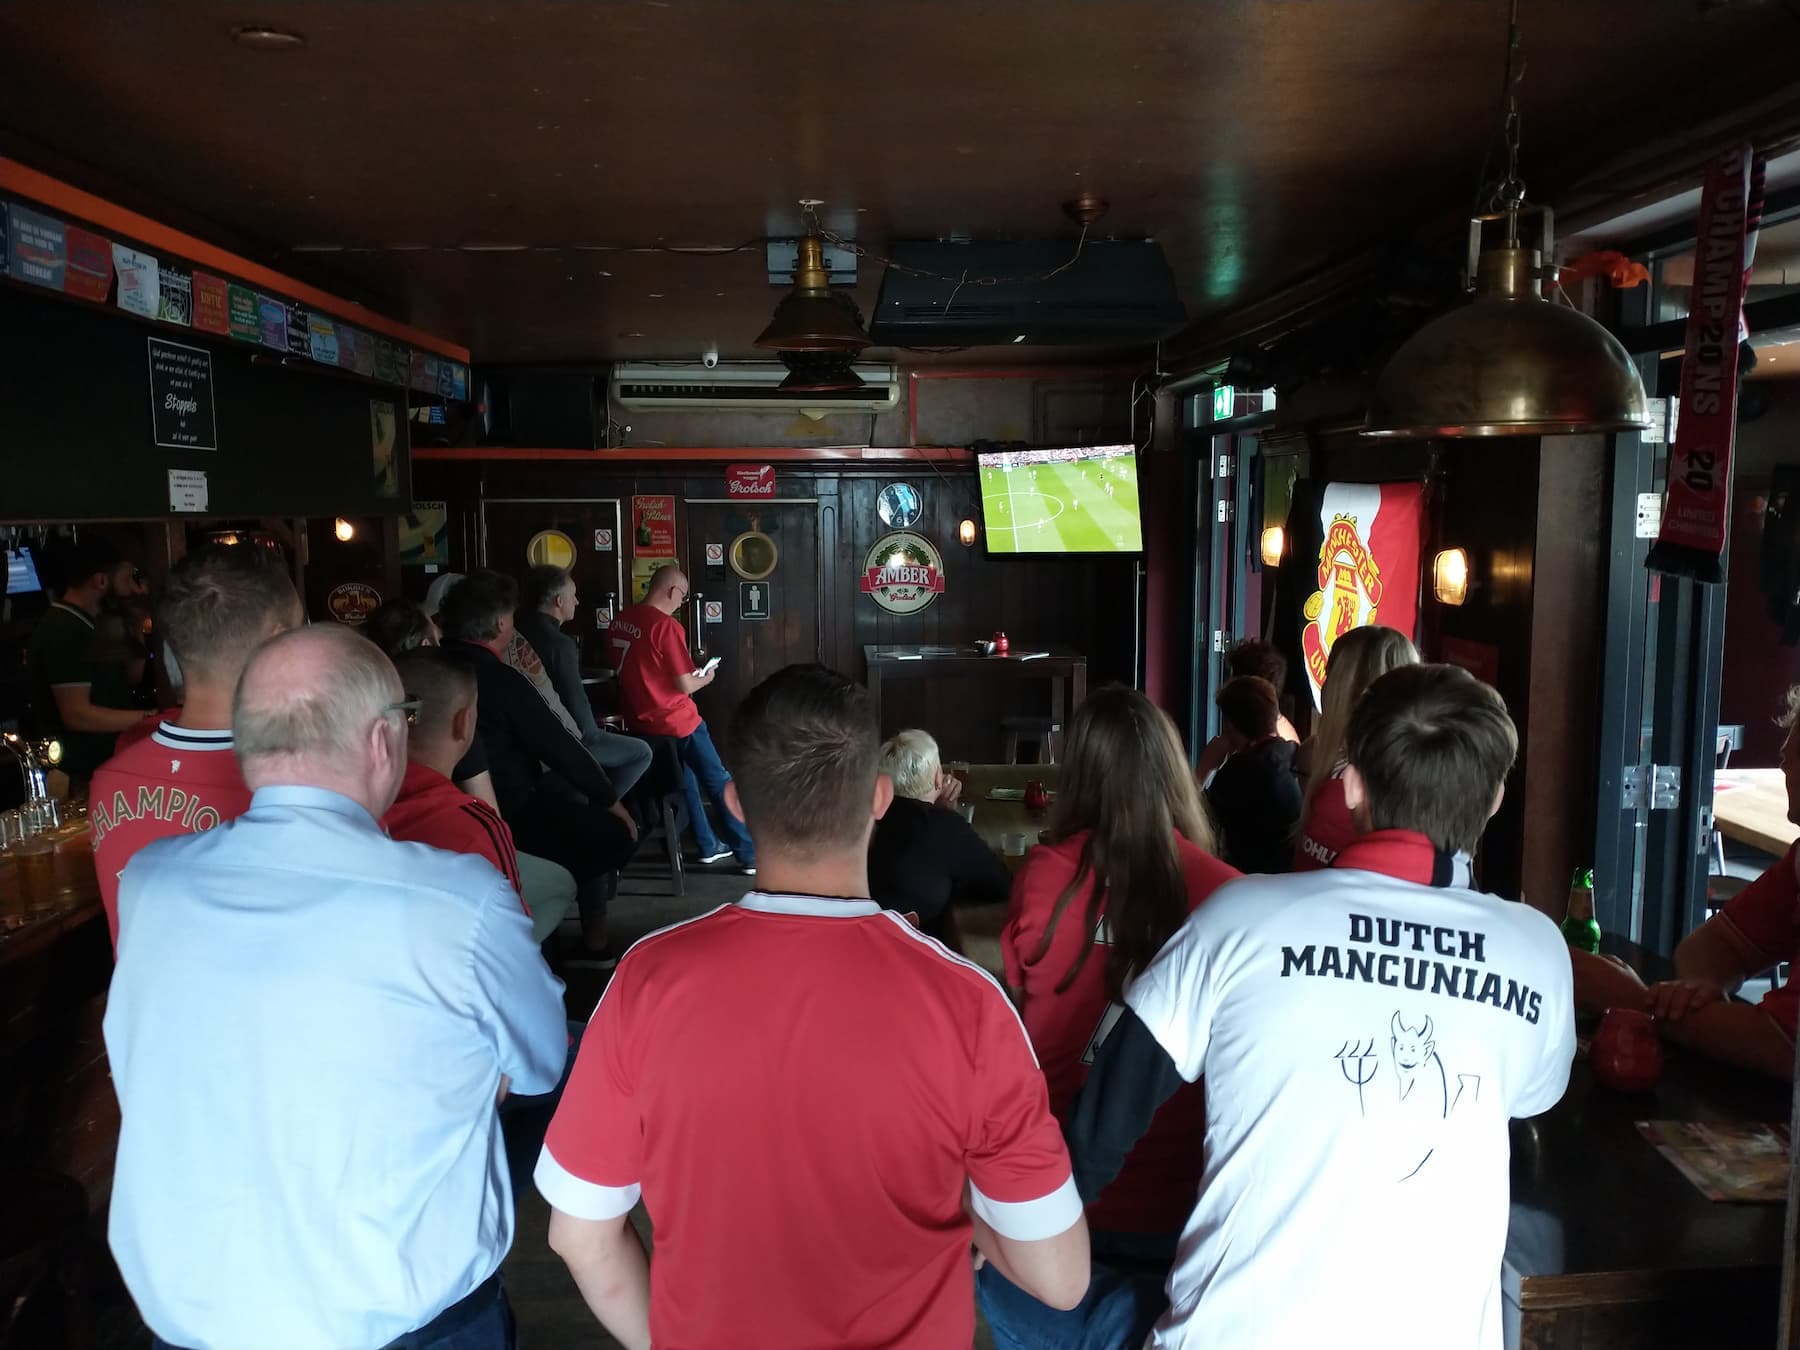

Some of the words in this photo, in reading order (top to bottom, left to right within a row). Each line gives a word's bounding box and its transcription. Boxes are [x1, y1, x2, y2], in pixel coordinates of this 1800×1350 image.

[729, 479, 774, 494] Grolsch
[1687, 449, 1714, 490] 20
[875, 567, 930, 585] AMBER
[1322, 527, 1375, 595] MANCHESTER
[611, 637, 631, 676] 7
[1349, 913, 1486, 963] DUTCH
[1280, 944, 1542, 1025] MANCUNIANS
